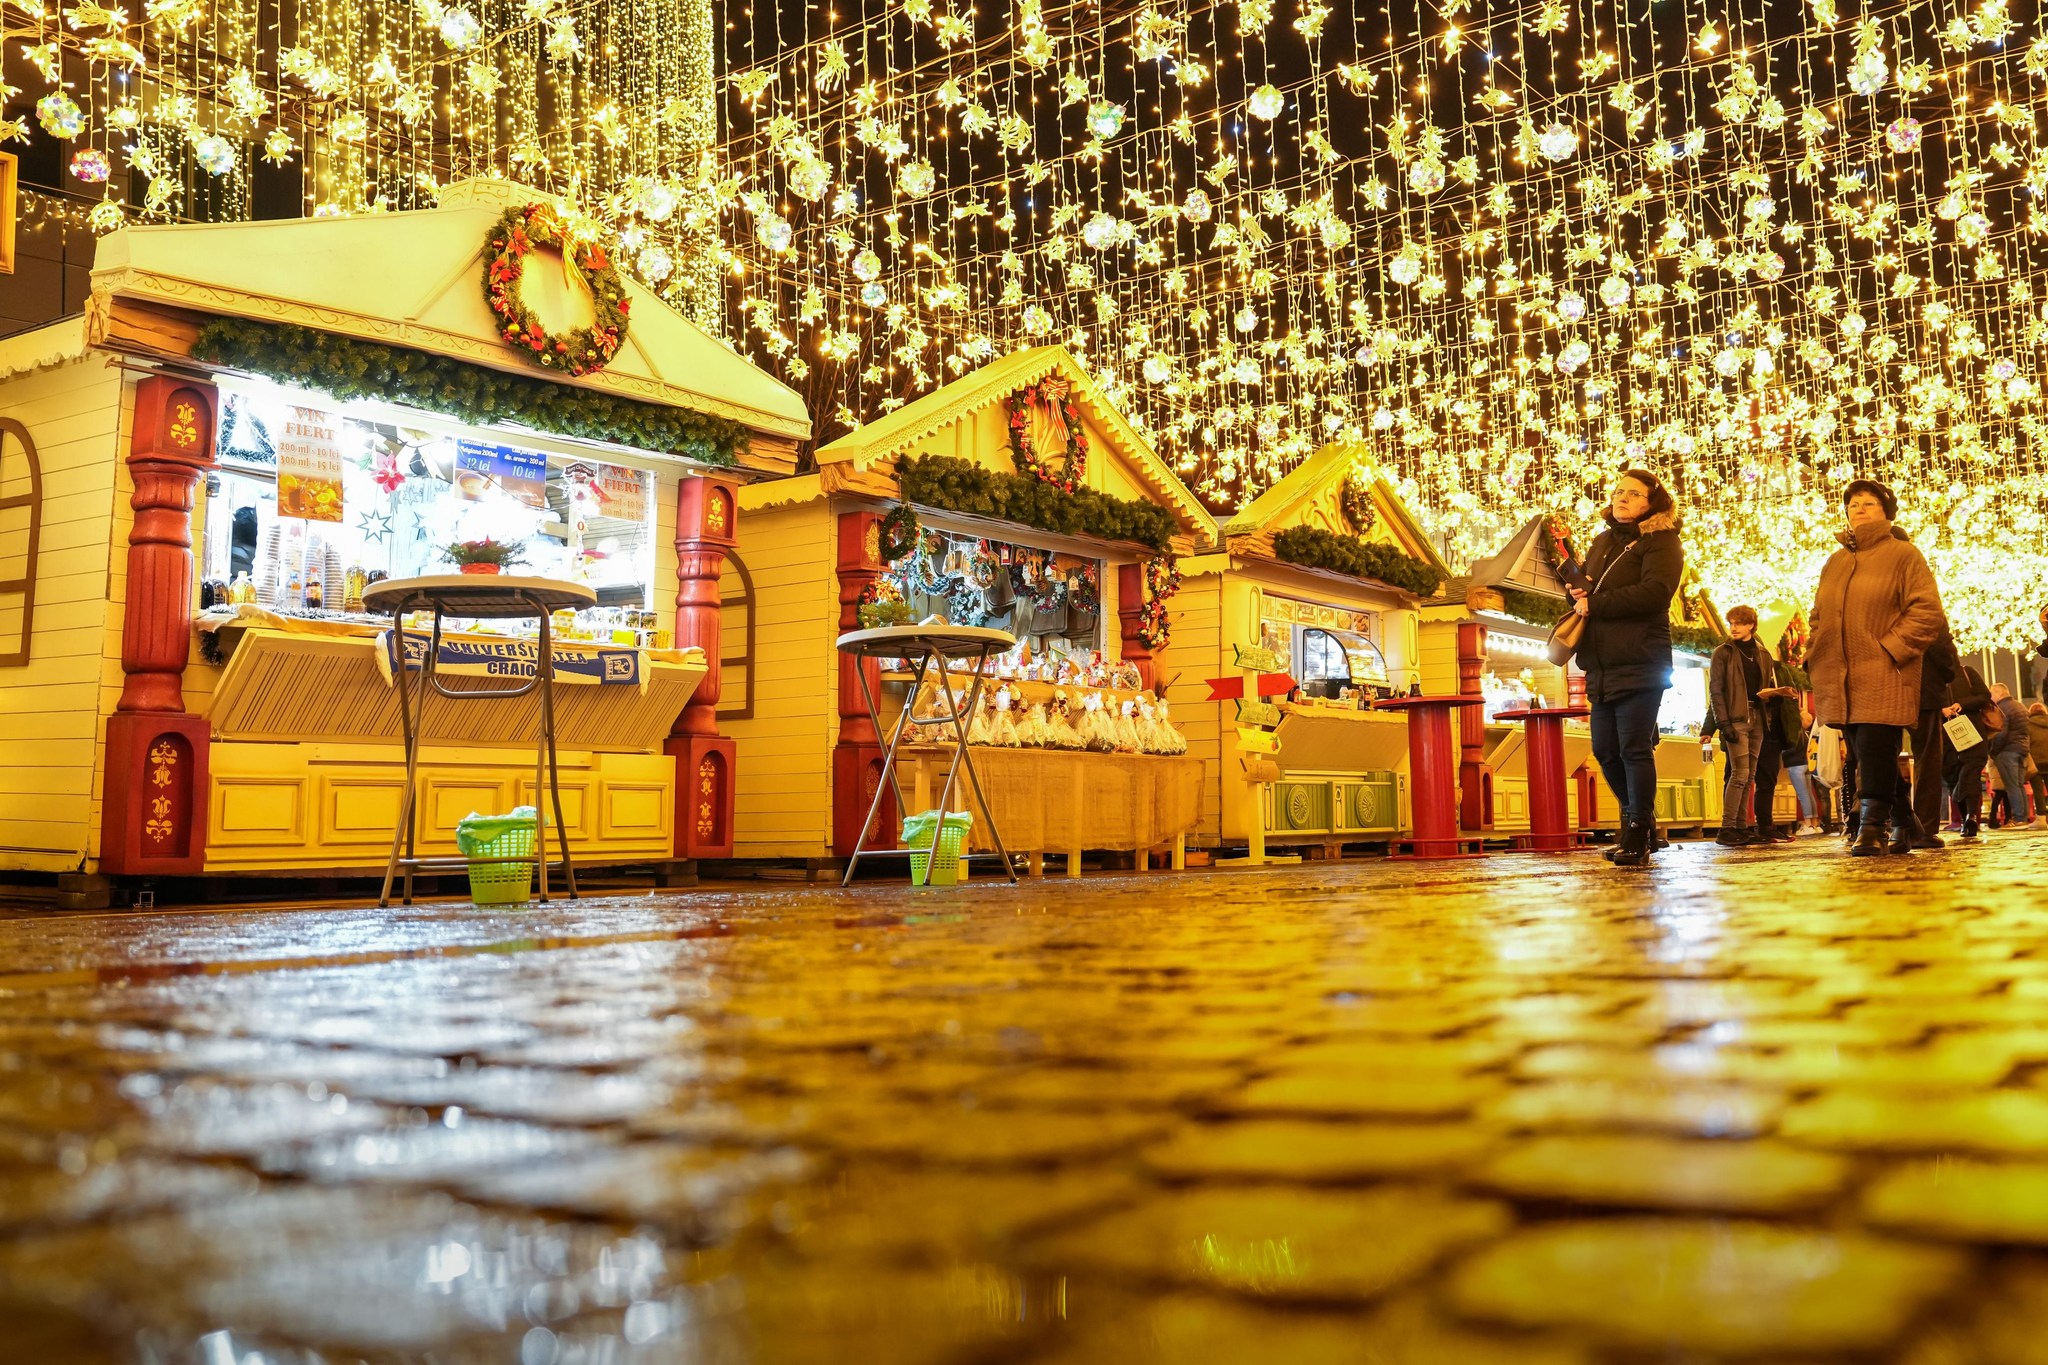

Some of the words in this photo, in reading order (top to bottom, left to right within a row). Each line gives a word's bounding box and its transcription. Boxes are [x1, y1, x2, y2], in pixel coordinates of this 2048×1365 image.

[294, 407, 326, 423] VIN
[285, 422, 335, 440] FIERT
[280, 442, 295, 452] 200
[298, 445, 309, 454] ml
[317, 448, 327, 457] 10
[329, 449, 339, 459] lei
[280, 455, 295, 465] 300
[298, 457, 309, 467] ml
[317, 461, 327, 471] 15
[329, 461, 339, 471] lei
[467, 457, 477, 469] 12
[479, 459, 491, 472] lei
[512, 465, 524, 477] 10
[525, 467, 537, 479] lei
[611, 465, 635, 479] VIN
[604, 478, 640, 494] FIERT
